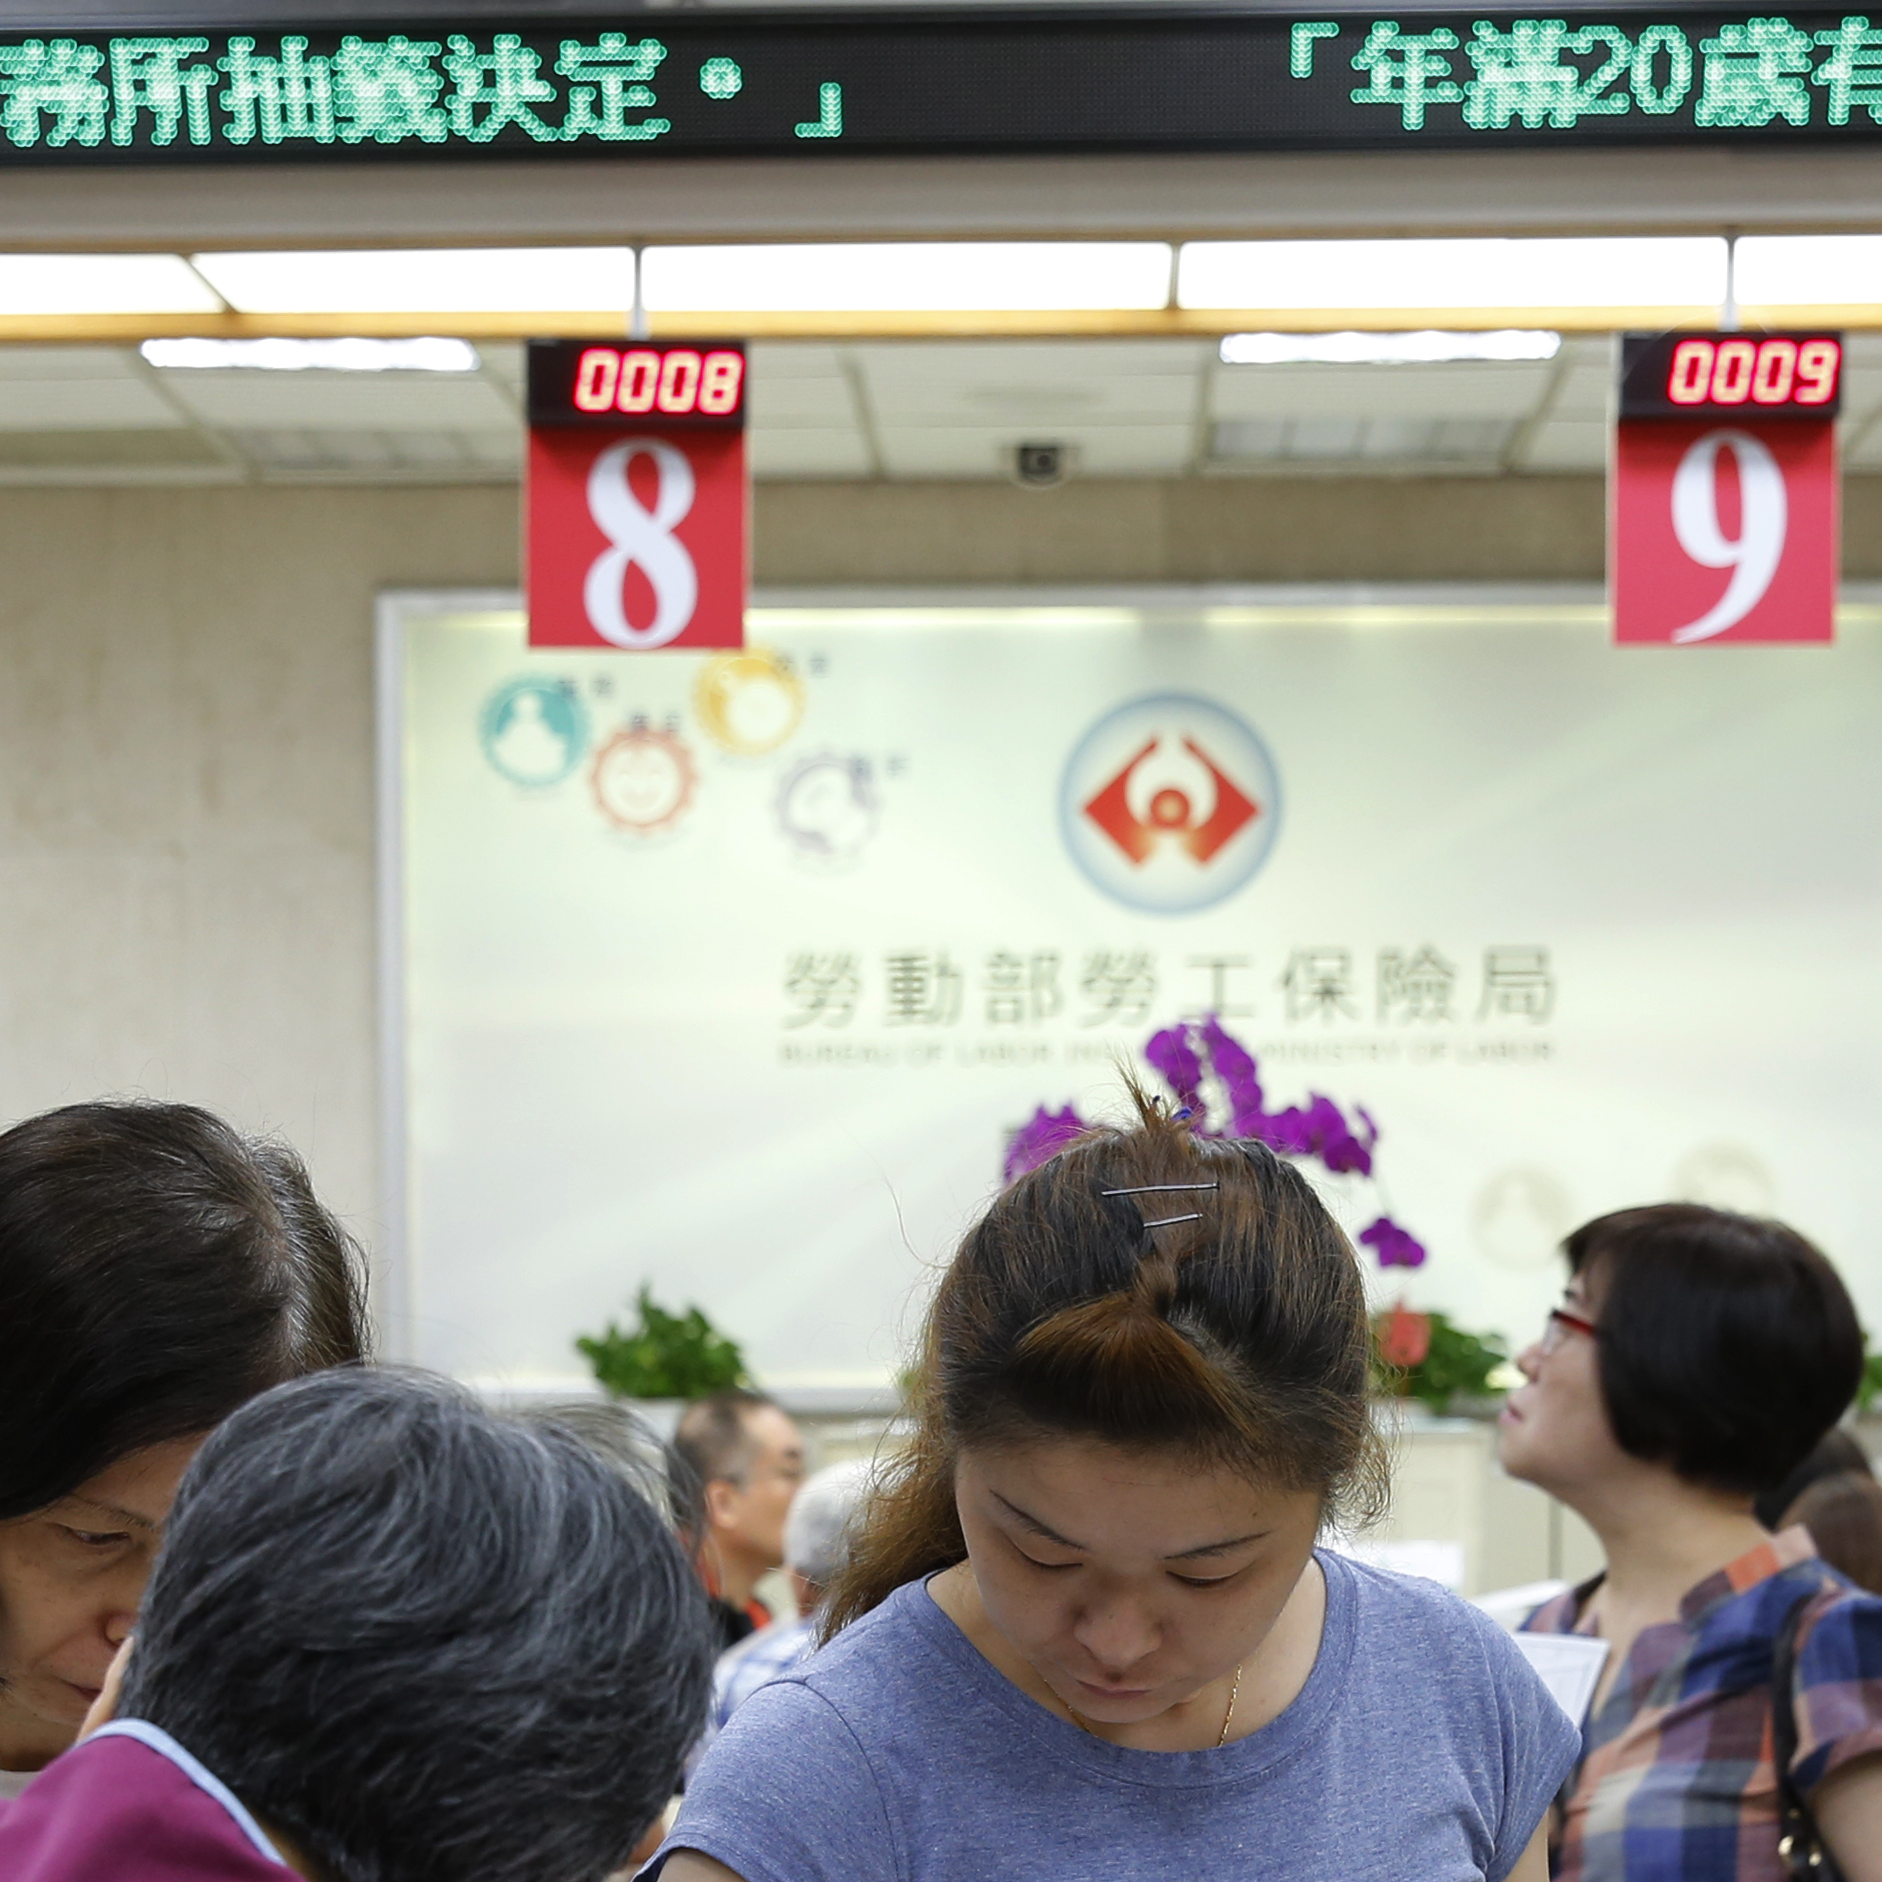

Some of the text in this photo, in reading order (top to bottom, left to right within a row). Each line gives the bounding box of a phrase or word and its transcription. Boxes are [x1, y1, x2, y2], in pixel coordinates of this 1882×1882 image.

[574, 346, 742, 415] 0008
[1668, 339, 1839, 405] 0009
[583, 439, 699, 650] 8
[1669, 428, 1789, 645] 9
[782, 947, 1558, 1030] 勞動部勞工保險局
